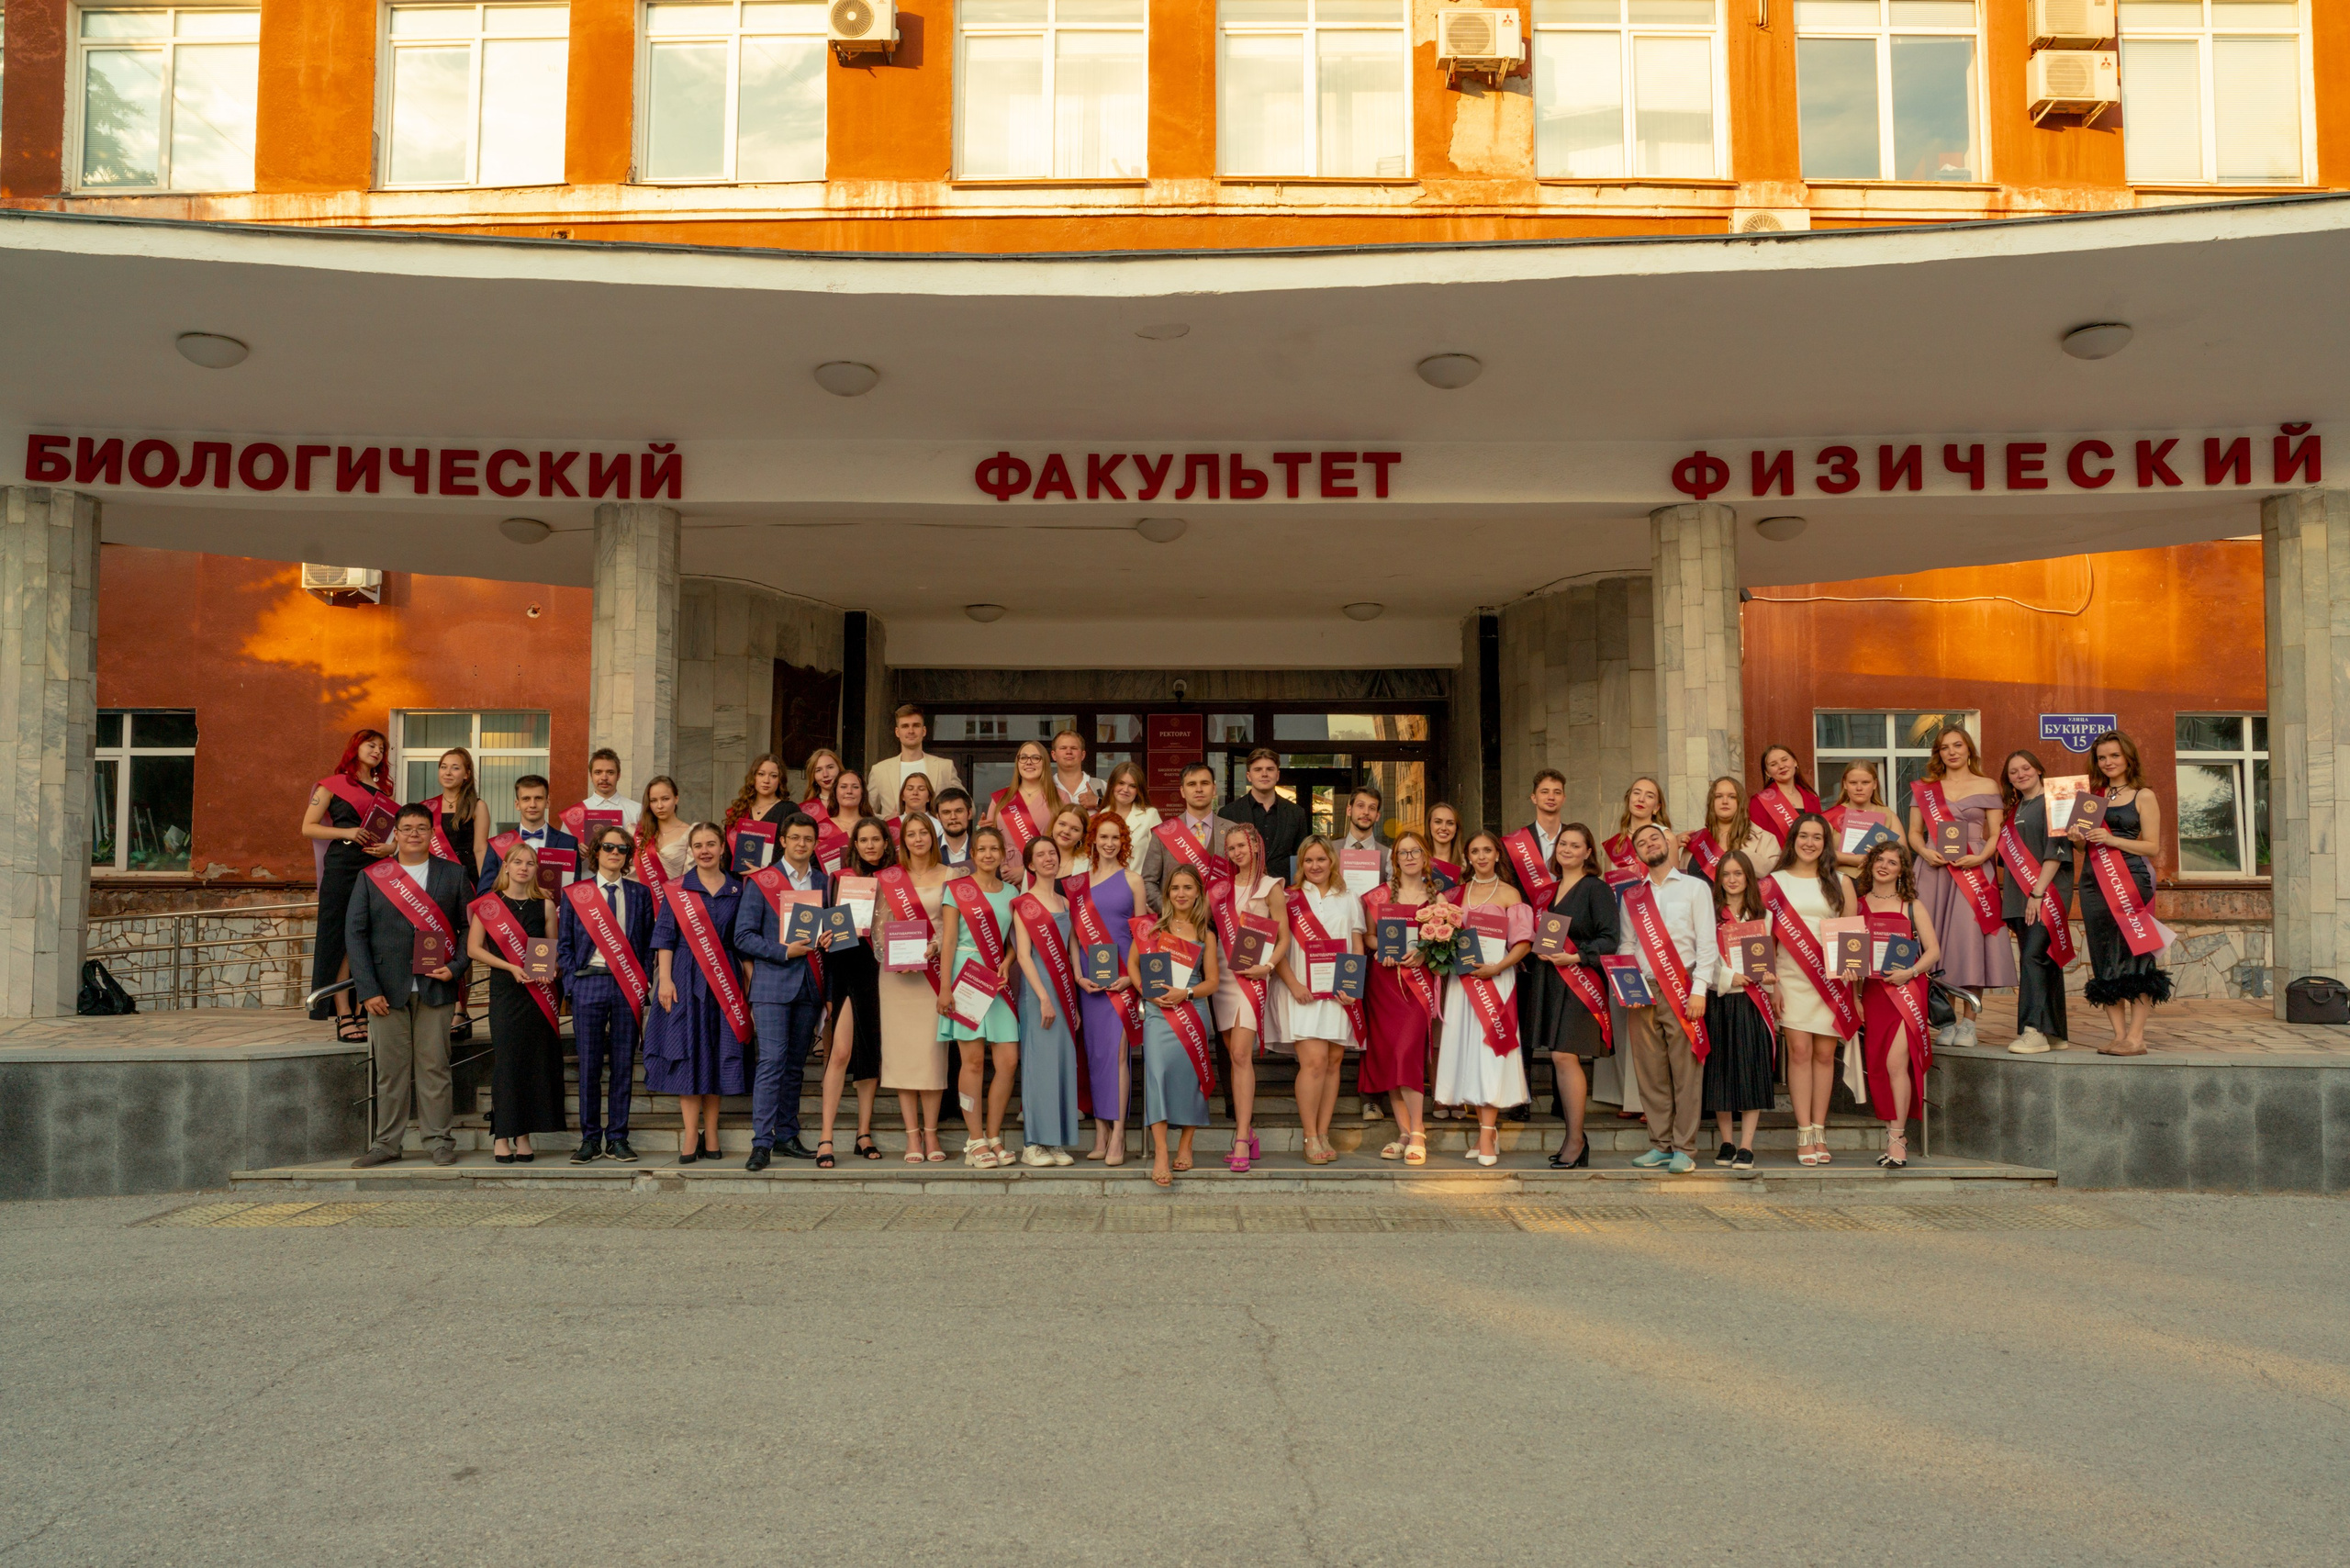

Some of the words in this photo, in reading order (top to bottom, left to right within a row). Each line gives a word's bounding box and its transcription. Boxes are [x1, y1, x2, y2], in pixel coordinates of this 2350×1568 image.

[25, 434, 682, 499] БИОЛОГИЧЕСКИЙ
[975, 451, 1402, 500] ФАКУЛЬТЕТ
[1672, 422, 2322, 499] ФИЗИЧЕСКИЙ
[2044, 724, 2113, 734] БУКИРЕВА
[2073, 735, 2087, 747] 15
[1174, 836, 1210, 877] ЛУЧШИЙ
[1516, 841, 1543, 888] ЛУЧШИЙ
[389, 879, 430, 917] ЛУЧШИЙ
[1978, 893, 1995, 918] 2024
[2001, 824, 2025, 867] ЛУЧШИЙ
[2056, 927, 2067, 951] 2024
[2098, 847, 2136, 917] ВЫПУСКНИК
[2128, 915, 2147, 939] 2024
[589, 907, 622, 954] ЛУЧШИЙ
[971, 906, 1000, 956] ЛУЧШИЙ
[1077, 894, 1102, 941] ЛУЧШИЙ
[498, 923, 526, 963] ЛУЧШИ
[677, 890, 706, 936] ЛУЧШИЙ
[699, 935, 736, 1004] ВЫПУСКНИК
[730, 1003, 746, 1026] 2024
[1037, 924, 1066, 973] ЛУЧШИЙ
[1159, 945, 1192, 961] БЛАГОДАРНОСТЬ
[1768, 898, 1801, 941] ЛУЧШИЙ
[1796, 939, 1843, 1003] ВЫПУСКНИК
[1839, 1002, 1853, 1023] 2024
[964, 970, 994, 991] БЛАГОДАРНОСТЬ
[1637, 902, 1663, 949] ЛУЧШИЙ
[1691, 1020, 1705, 1045] 2024
[1127, 1007, 1142, 1030] 2024
[1491, 1015, 1507, 1039] 2024
